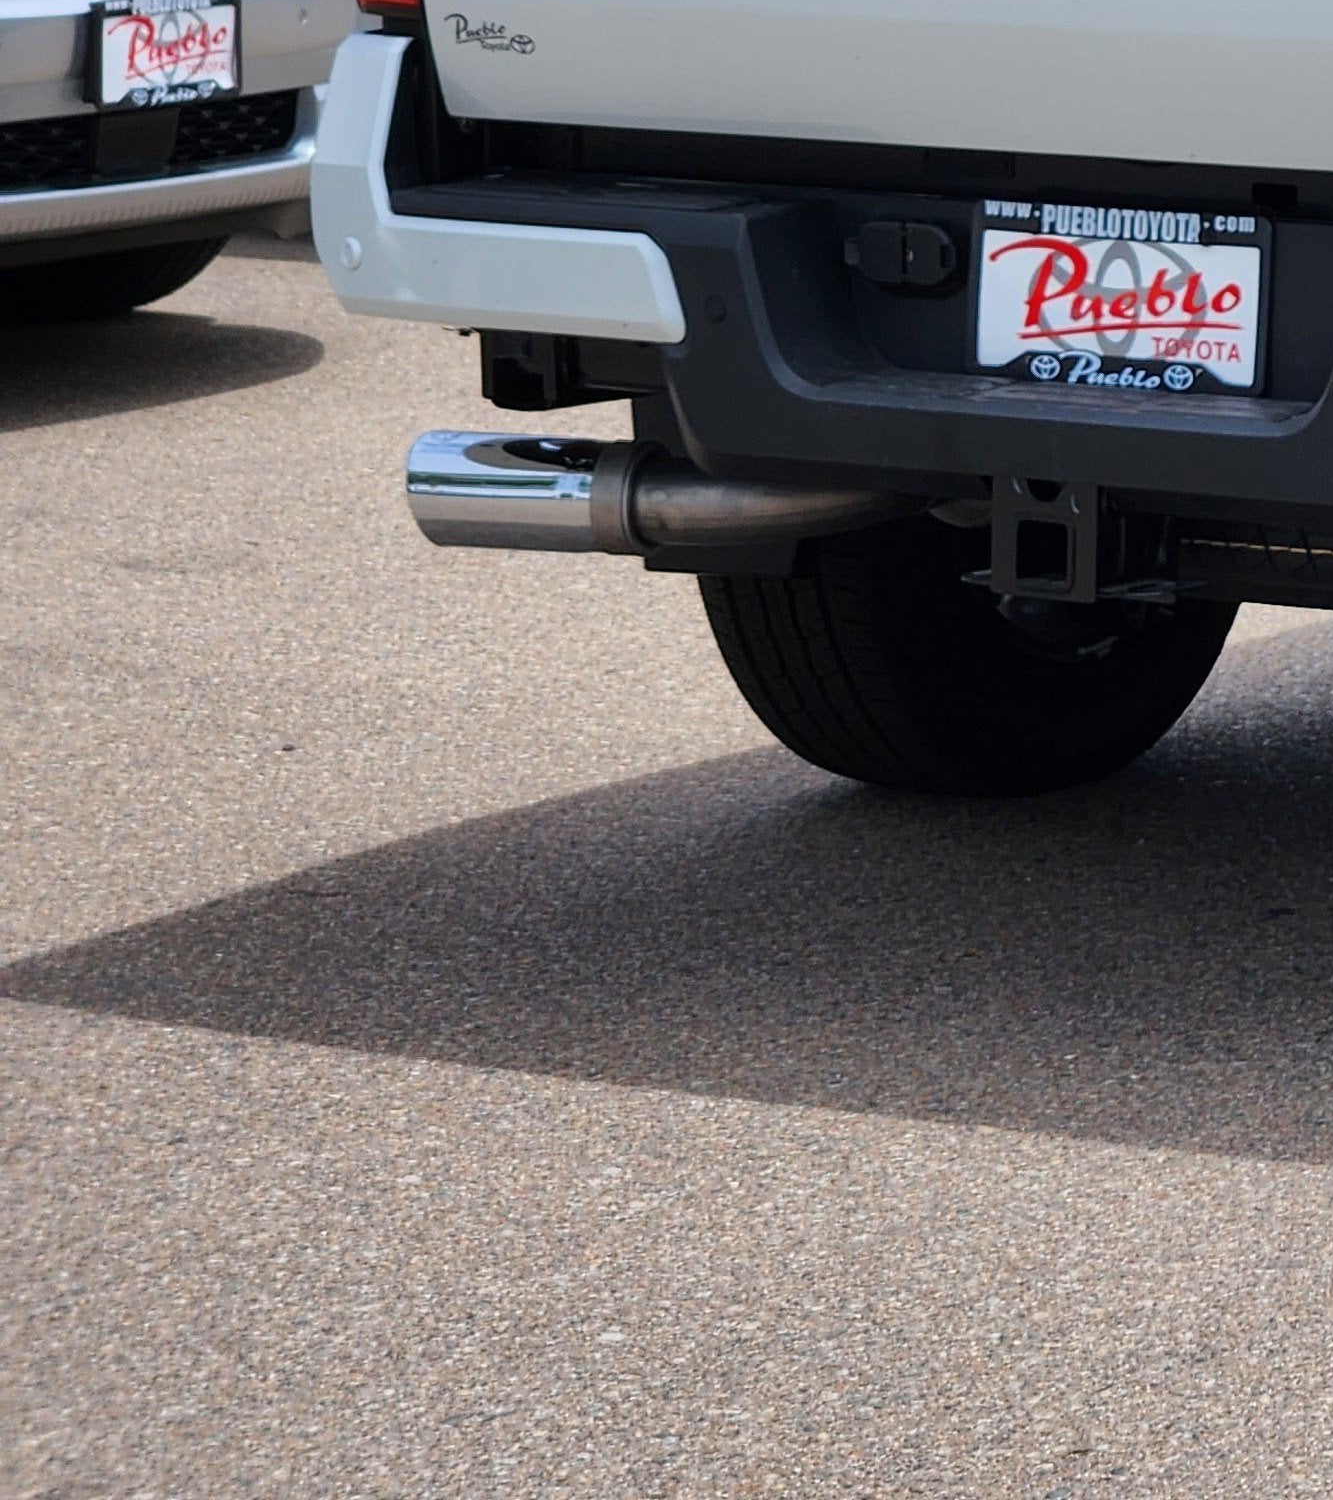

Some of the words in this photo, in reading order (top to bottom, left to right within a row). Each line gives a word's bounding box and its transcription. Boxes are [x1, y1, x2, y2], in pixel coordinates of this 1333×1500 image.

[988, 237, 1243, 327] Pueblo
[1058, 350, 1161, 390] Pueblo
[1152, 336, 1243, 364] TOYOTA
